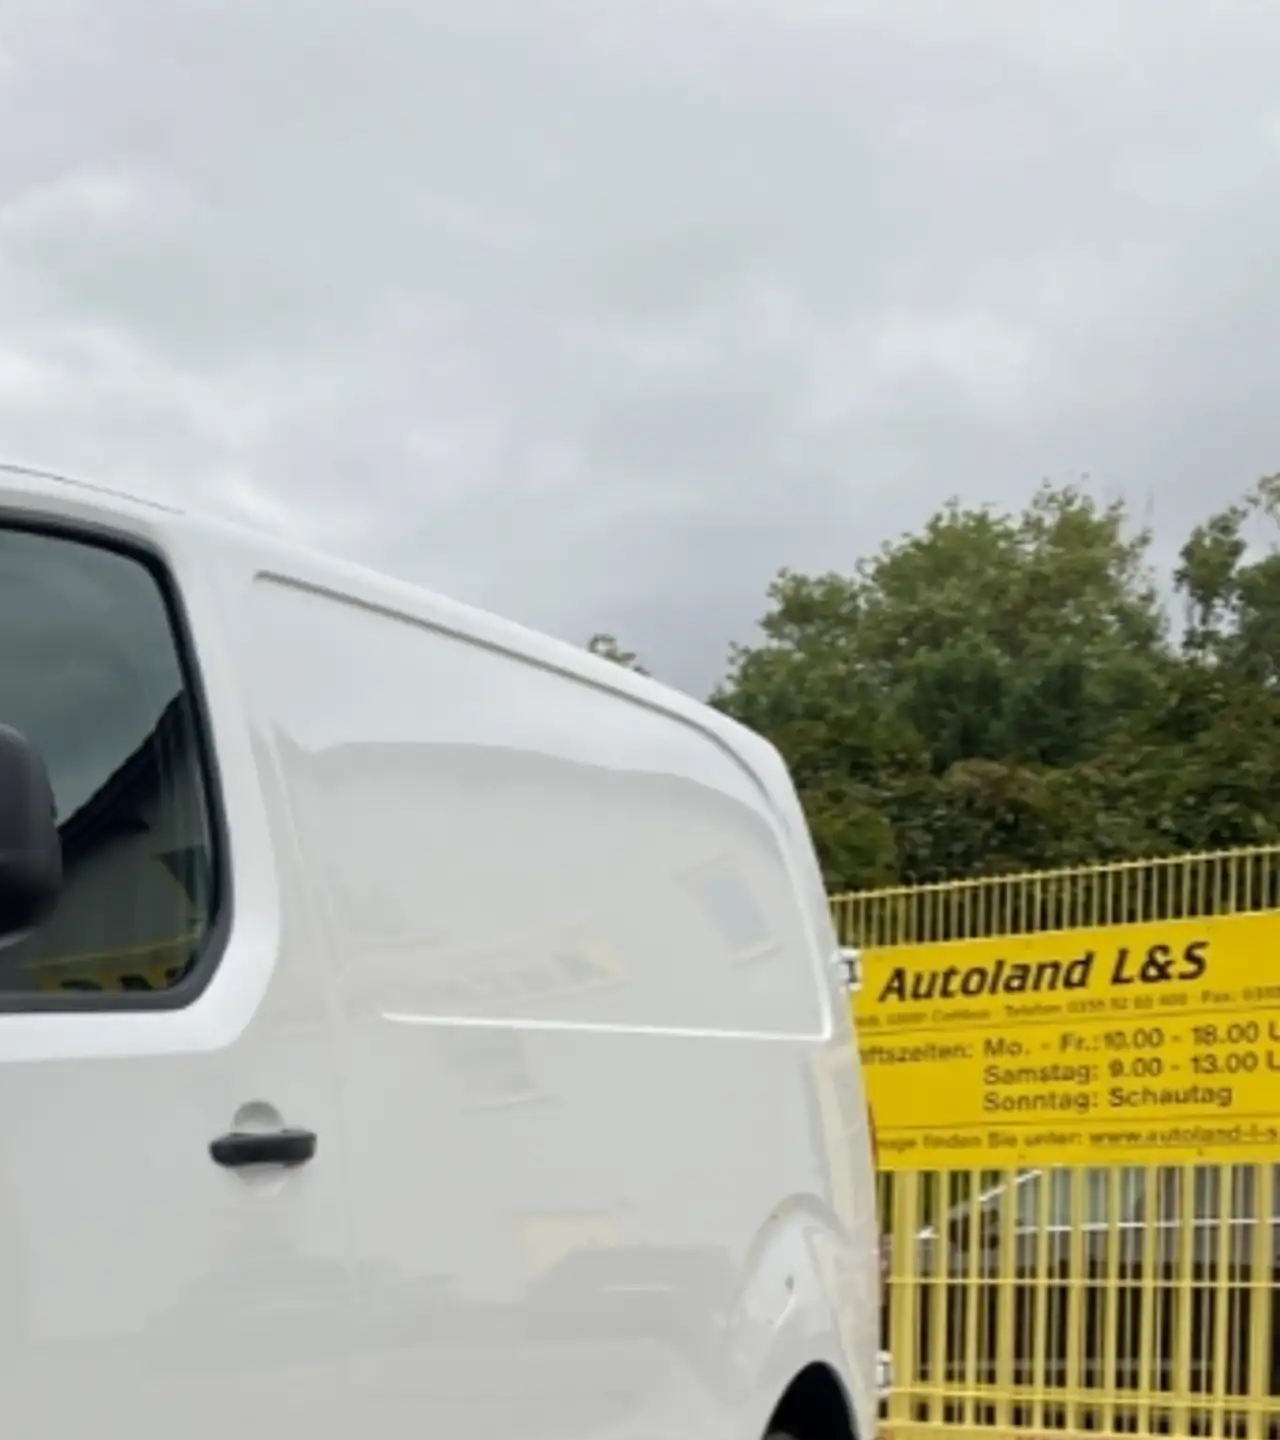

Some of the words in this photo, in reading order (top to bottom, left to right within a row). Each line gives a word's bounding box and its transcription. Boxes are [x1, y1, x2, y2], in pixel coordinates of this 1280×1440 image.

[878, 952, 1095, 1004] Autoland
[1110, 941, 1210, 986] L&S
[983, 1037, 1031, 1058] Mo.
[983, 1060, 1100, 1087] Samstag:
[1108, 1056, 1163, 1079] 9.00
[1191, 1051, 1260, 1076] 13.00
[983, 1089, 1100, 1115] Sonntag:
[1107, 1084, 1234, 1109] Schautag
